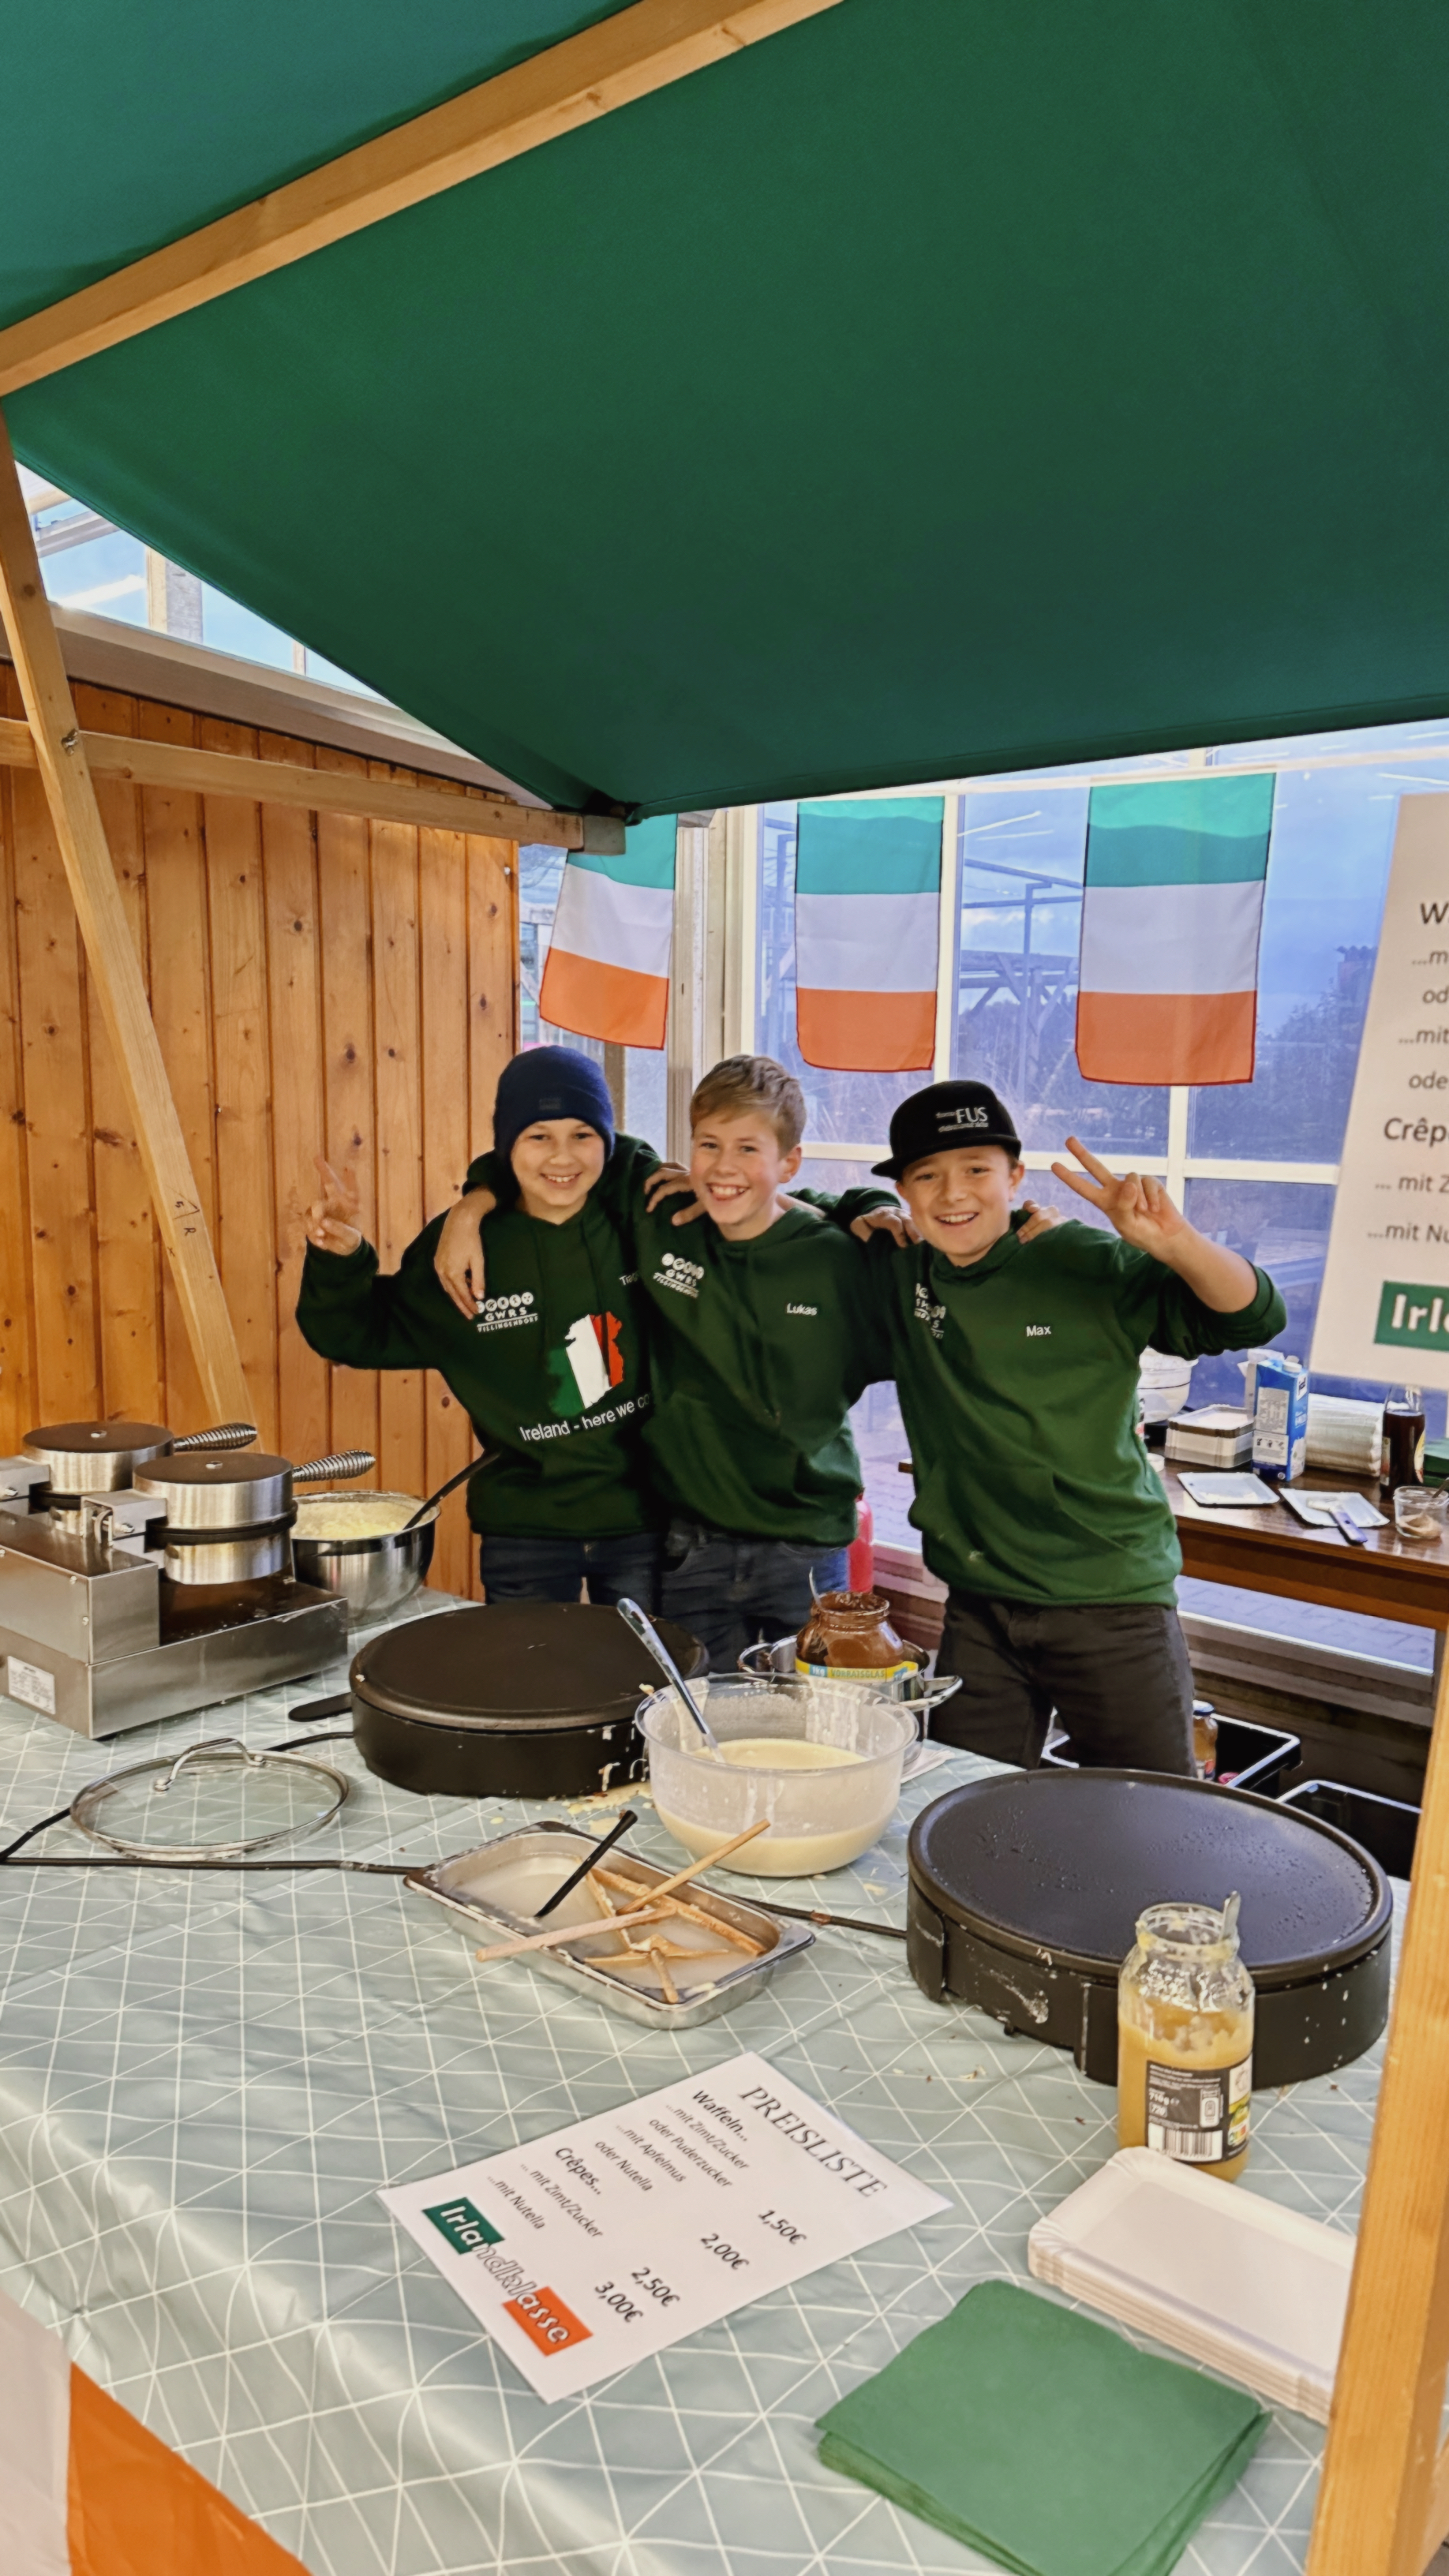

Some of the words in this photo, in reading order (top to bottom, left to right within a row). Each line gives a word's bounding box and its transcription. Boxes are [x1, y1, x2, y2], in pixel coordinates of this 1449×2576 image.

[1420, 902, 1449, 924] W
[955, 1106, 988, 1124] FUS
[1383, 1117, 1449, 1148] Crêp
[1398, 1174, 1433, 1193] mit
[485, 1306, 527, 1322] GWRS
[786, 1302, 818, 1316] Lukas
[1026, 1324, 1052, 1337] Max
[519, 1421, 571, 1441] Ireland
[581, 1410, 616, 1429] here
[616, 1400, 635, 1418] we
[637, 1393, 650, 1409] co
[812, 1666, 826, 1677] 1kg
[831, 1668, 885, 1678] VORRATSGLAS
[692, 2090, 747, 2142] Waffeln...
[639, 2144, 686, 2183] Apfelmus
[689, 2121, 750, 2170] Zimt/Zucker
[738, 2084, 888, 2197] PREISLISTE
[555, 2147, 601, 2196] Crêpes...
[649, 2119, 675, 2139] oder
[671, 2136, 732, 2187] Puderzucker
[758, 2209, 807, 2245] 1,50€
[594, 2140, 621, 2162] oder
[616, 2159, 653, 2192] Nutella
[700, 2233, 749, 2271] 2,00€
[510, 2195, 545, 2230] Nutella
[594, 2281, 643, 2323] 3,00€
[530, 2169, 551, 2187] mit
[545, 2183, 604, 2237] Zimt/Zucker
[631, 2267, 680, 2308] 2,50€
[440, 2206, 571, 2344] Irlandklasse
